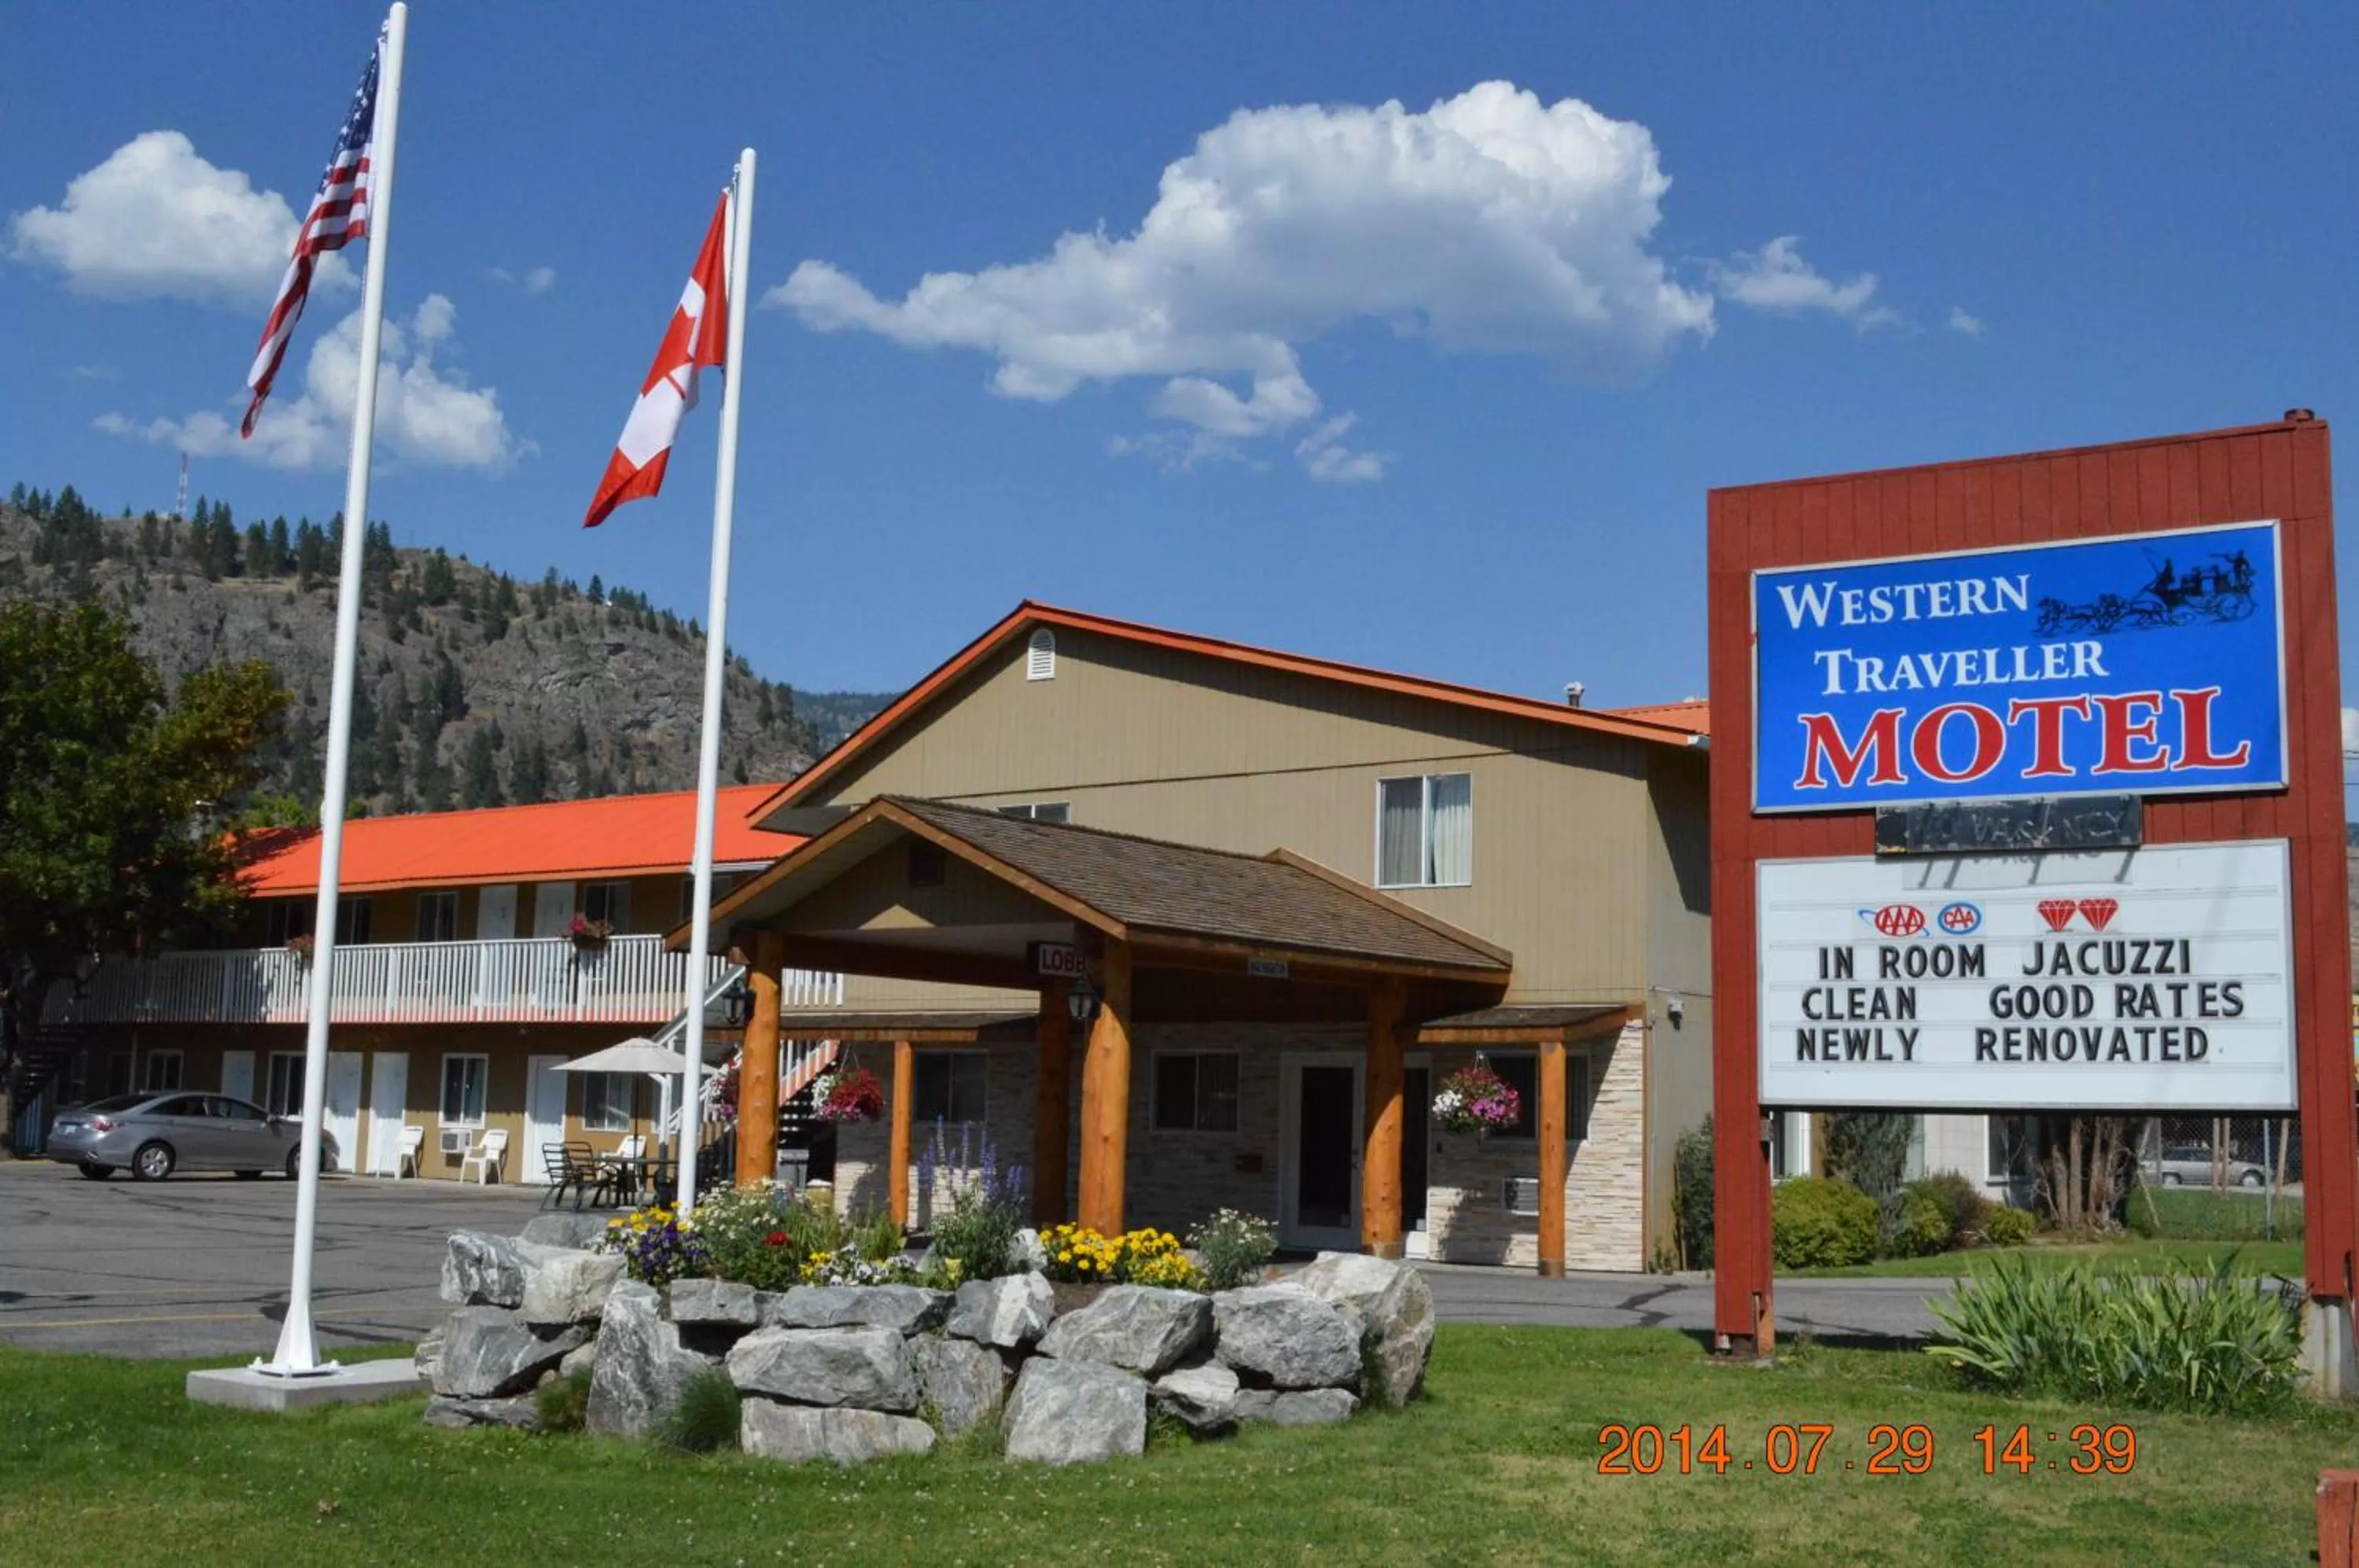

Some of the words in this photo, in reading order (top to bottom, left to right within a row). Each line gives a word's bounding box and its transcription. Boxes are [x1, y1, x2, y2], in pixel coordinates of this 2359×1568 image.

[1776, 573, 2029, 629] WESTERN
[1814, 640, 2110, 695] TRAVELLER
[1794, 686, 2252, 790] MOTEL
[1943, 906, 1974, 929] CAA
[1819, 946, 1854, 980] IN
[1879, 944, 1985, 979] ROOM
[2022, 938, 2191, 977] JACUZZI
[1801, 986, 1917, 1021] CLEAN
[1989, 985, 2095, 1020] GOOD
[2114, 981, 2245, 1018] RATES
[1796, 1027, 1920, 1061] NEWLY
[1975, 1025, 2209, 1062] RENOVATED
